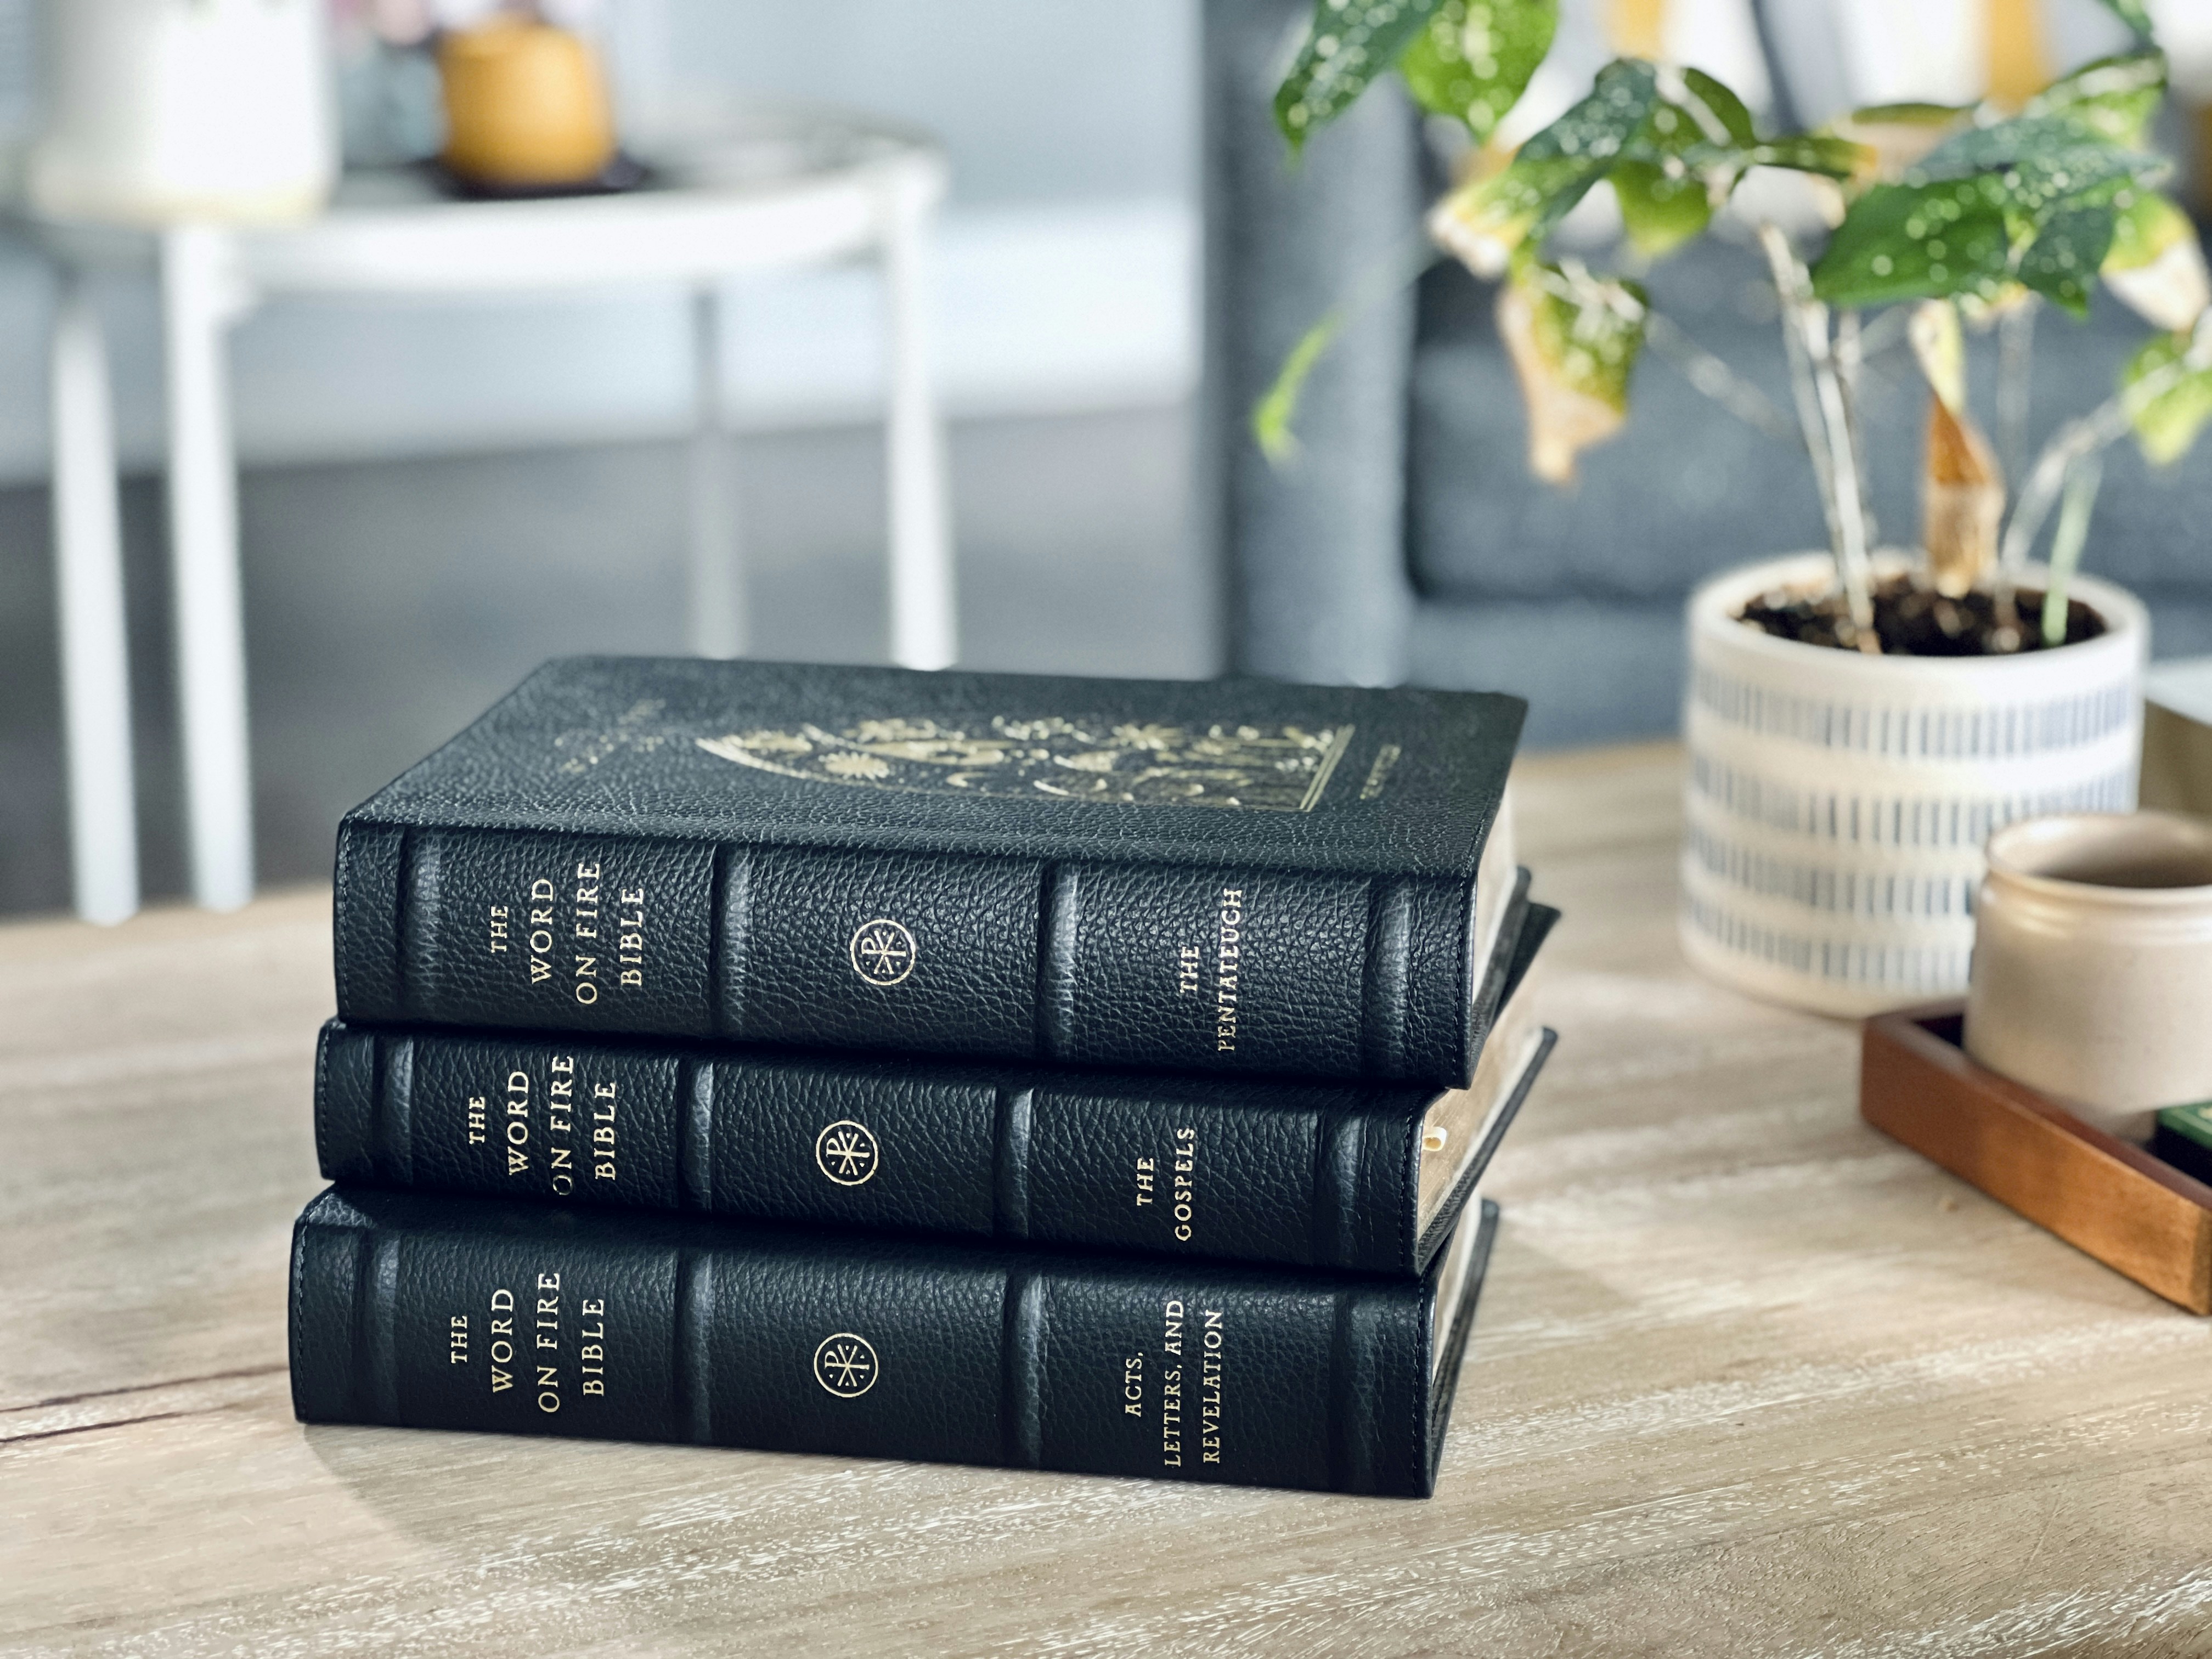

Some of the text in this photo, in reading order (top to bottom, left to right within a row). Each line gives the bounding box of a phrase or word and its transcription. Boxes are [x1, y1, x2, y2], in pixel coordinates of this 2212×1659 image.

[491, 906, 508, 953] THE
[530, 879, 554, 984] WORD
[575, 863, 600, 1005] ON FIRE
[620, 888, 644, 986] BIBLE
[1180, 946, 1200, 993] THE
[1217, 888, 1243, 1052] PENTATEUCH
[469, 1096, 486, 1144] THE
[507, 1071, 529, 1176] WORD
[550, 1056, 574, 1195] ON FIRE
[594, 1082, 616, 1180] BIBLE
[1137, 1158, 1154, 1206] THE
[1175, 1128, 1194, 1242] GOSPELS
[450, 1316, 467, 1364] THE
[491, 1289, 514, 1393] WORD
[537, 1272, 560, 1413] ON FIRE
[582, 1299, 604, 1397] BIBLE
[1125, 1352, 1144, 1417] ACTS,
[1164, 1300, 1184, 1467] LETTERS, AND
[1203, 1309, 1223, 1464] REVELATION
